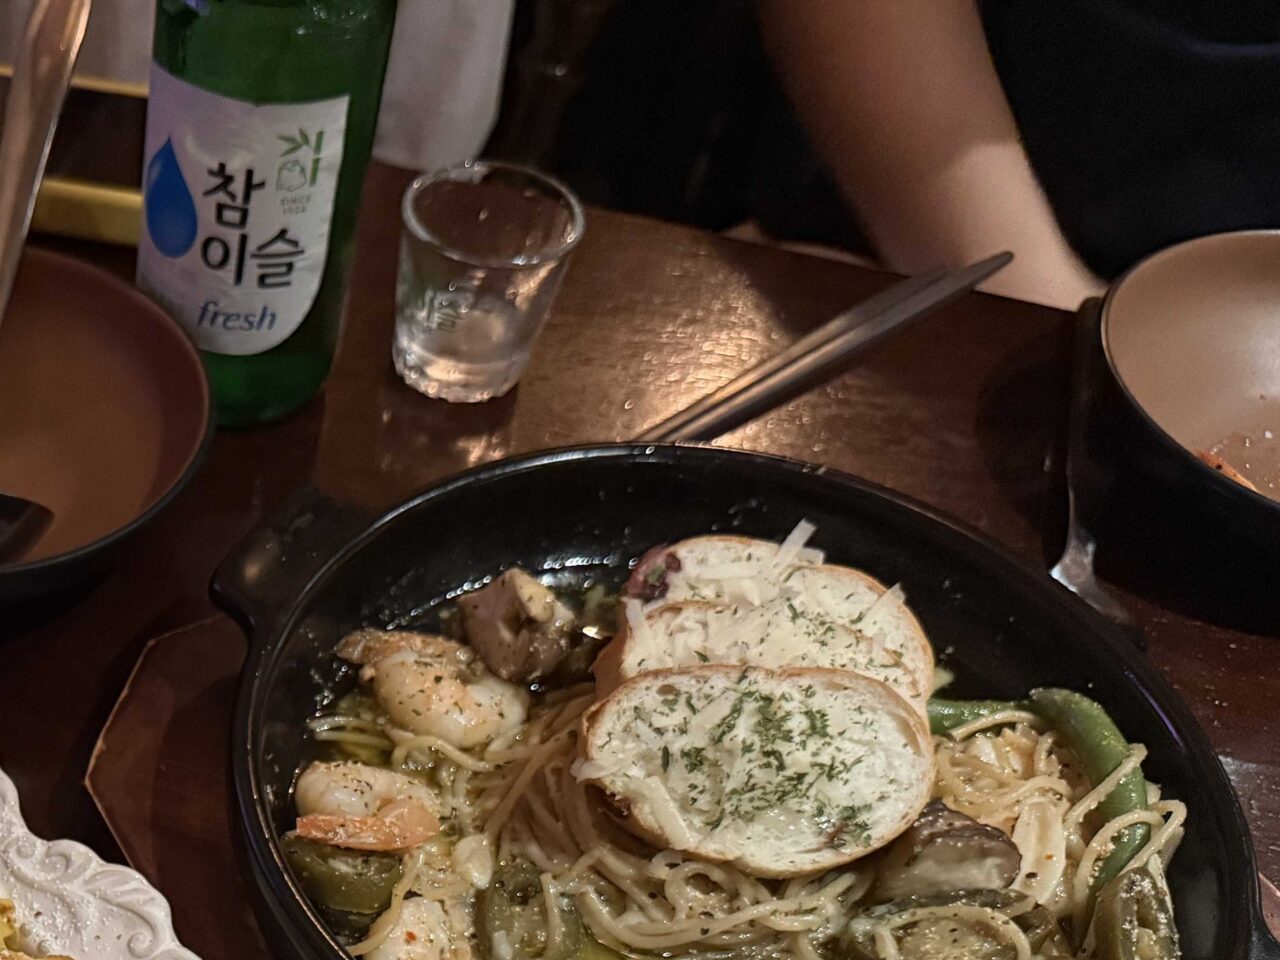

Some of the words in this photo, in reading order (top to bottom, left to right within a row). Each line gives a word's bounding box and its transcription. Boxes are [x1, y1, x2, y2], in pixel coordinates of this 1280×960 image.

[202, 162, 266, 229] 참
[201, 226, 305, 288] 이슬
[198, 301, 277, 331] fresh
